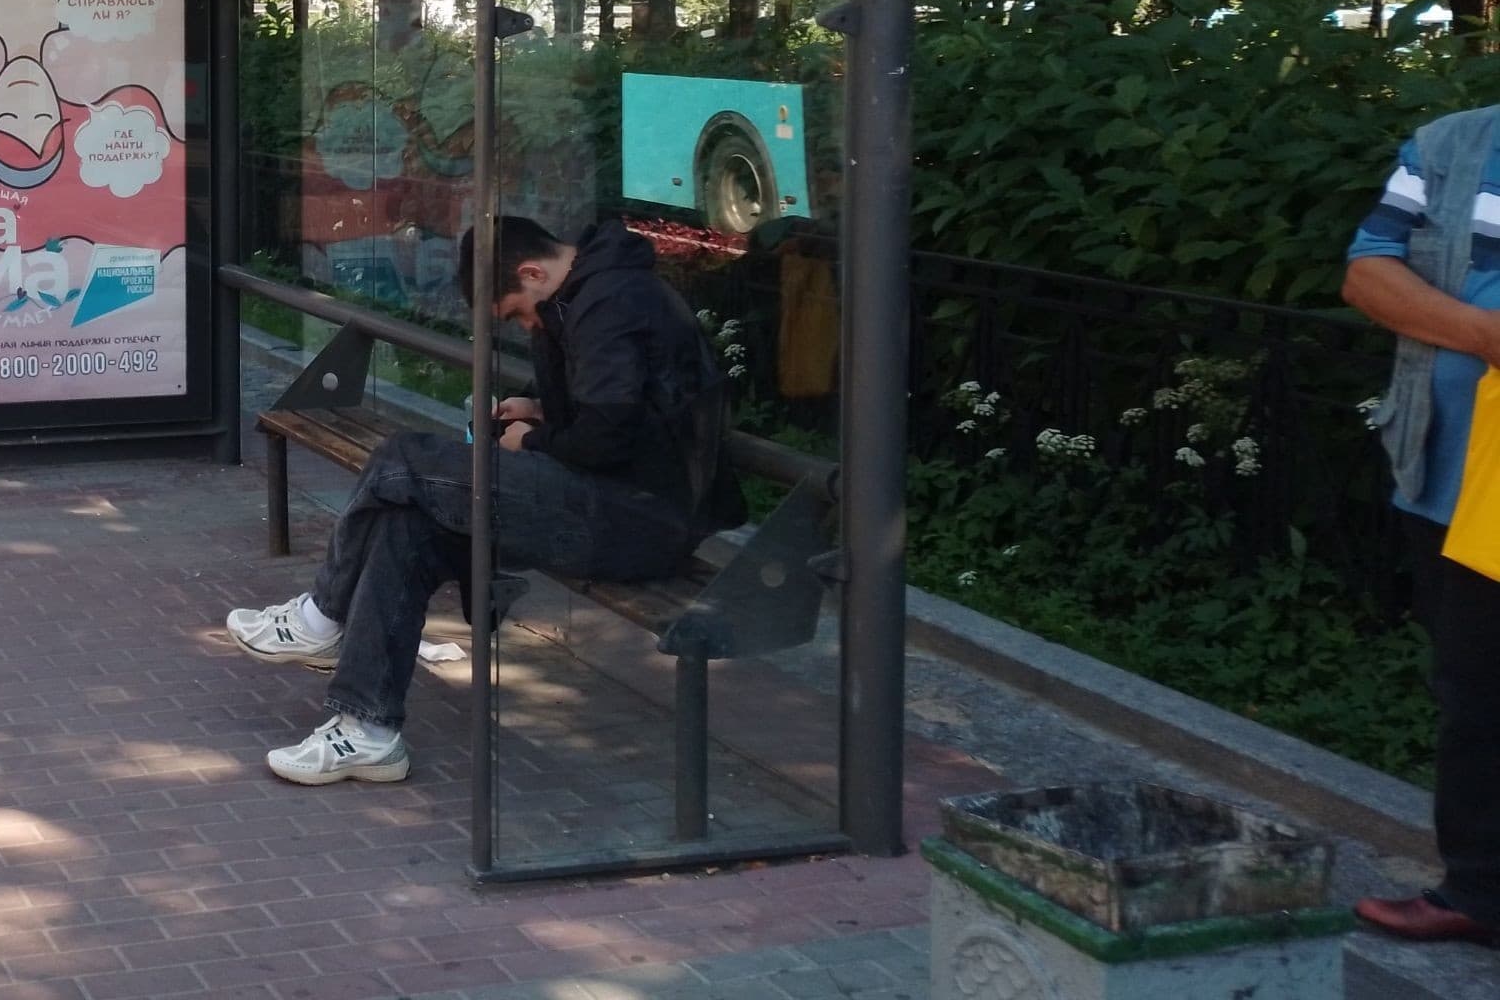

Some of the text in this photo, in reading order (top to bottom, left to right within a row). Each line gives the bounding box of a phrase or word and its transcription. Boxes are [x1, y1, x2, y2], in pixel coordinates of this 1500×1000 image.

[92, 10, 132, 21] ЛИ Я?
[114, 130, 133, 139] ГДЕ
[88, 151, 160, 163] ПОДДЕРЖКУ?
[19, 339, 52, 348] ЛИНИЯ
[54, 336, 111, 347] ПОДДЕРЖКИ
[114, 334, 161, 344] ОТВЕЧАЕТ
